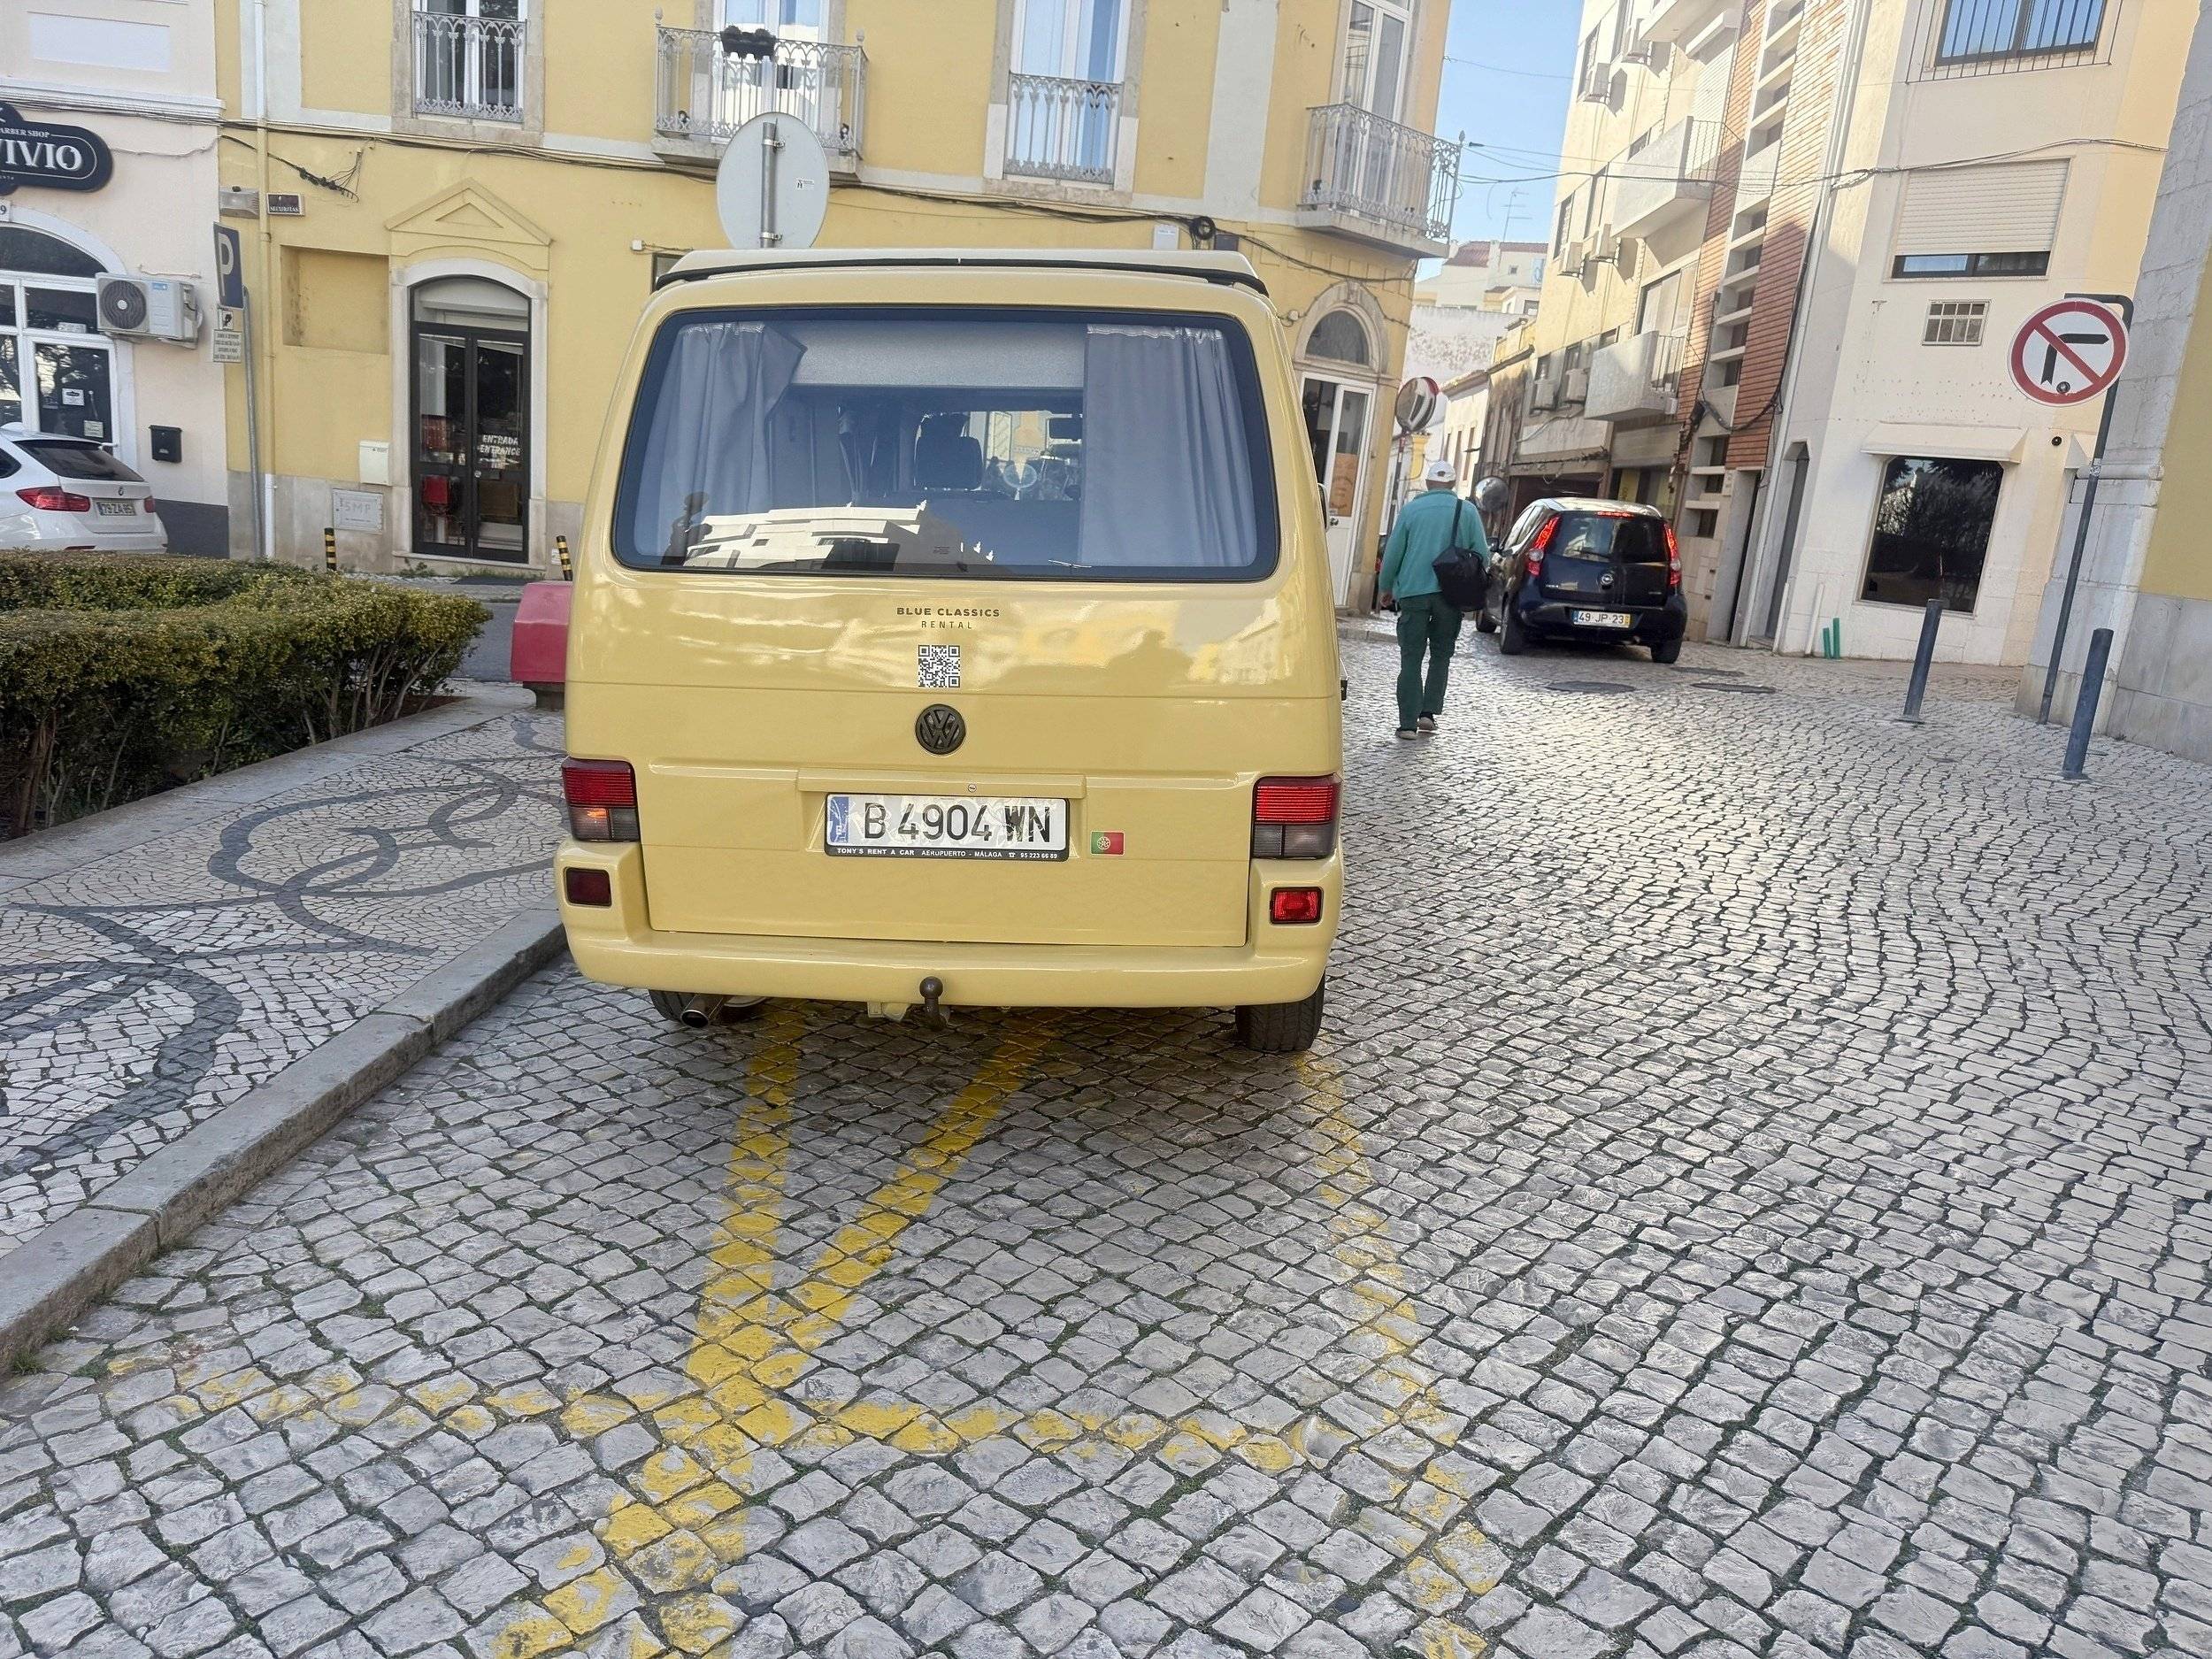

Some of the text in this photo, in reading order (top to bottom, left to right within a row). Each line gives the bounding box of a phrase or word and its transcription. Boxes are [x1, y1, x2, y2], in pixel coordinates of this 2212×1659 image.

[0, 138, 82, 172] IVIO
[218, 232, 234, 296] P
[482, 434, 518, 445] ENTRADA
[480, 444, 521, 456] ENTRANCE
[896, 607, 1000, 618] BLUE CLASSICS
[921, 620, 972, 629] RENTAL
[864, 803, 886, 839] B
[897, 803, 993, 841] 4904
